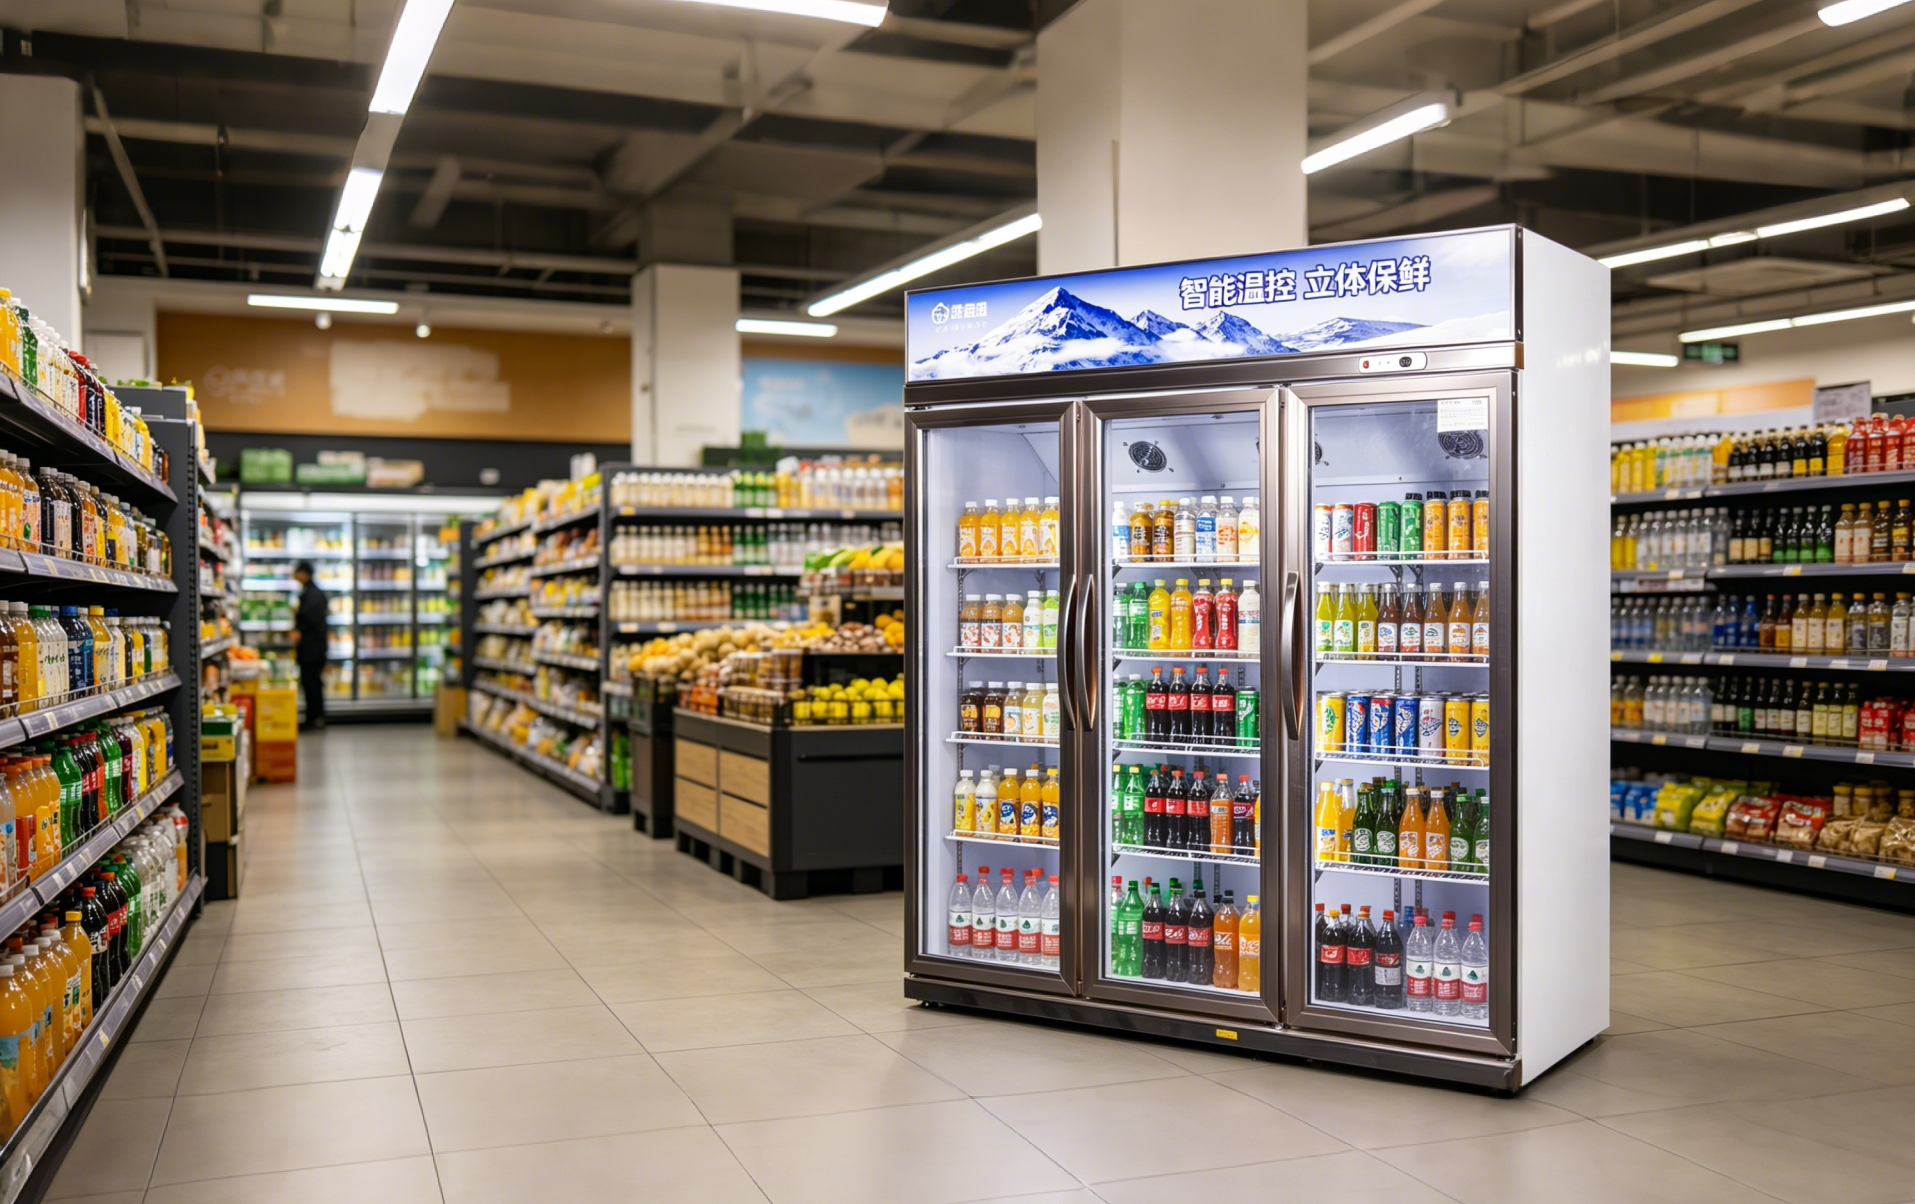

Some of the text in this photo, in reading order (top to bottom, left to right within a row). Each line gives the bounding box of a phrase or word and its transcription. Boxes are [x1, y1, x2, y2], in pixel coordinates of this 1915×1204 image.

[1180, 255, 1431, 310] 智能温控 立体保鲜
